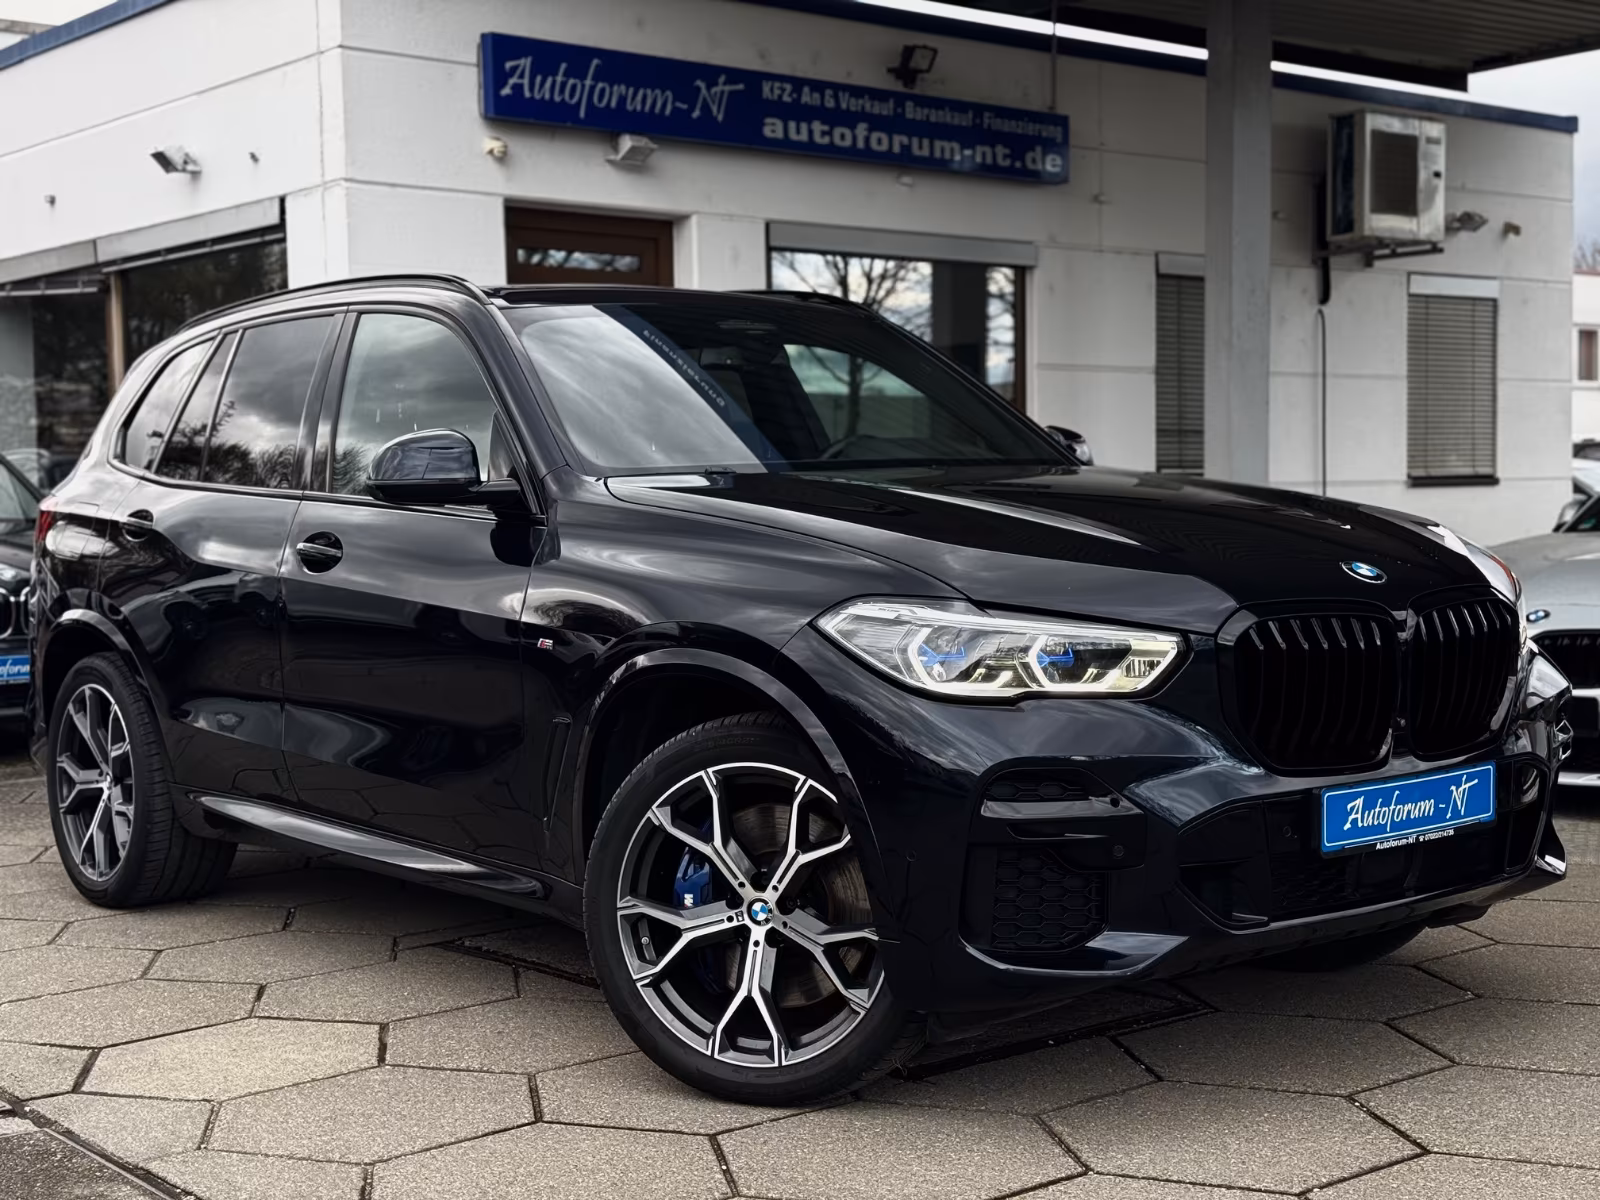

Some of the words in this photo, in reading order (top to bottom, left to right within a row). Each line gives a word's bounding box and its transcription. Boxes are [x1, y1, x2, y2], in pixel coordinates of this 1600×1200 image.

[801, 85, 820, 106] An
[824, 88, 836, 108] &
[838, 90, 894, 116] Verkauf
[904, 99, 973, 126] Barankauf
[982, 111, 1063, 143] Finanzierung
[762, 116, 1063, 173] autoforum-nt.de
[1375, 834, 1417, 850] Autoforum-NT
